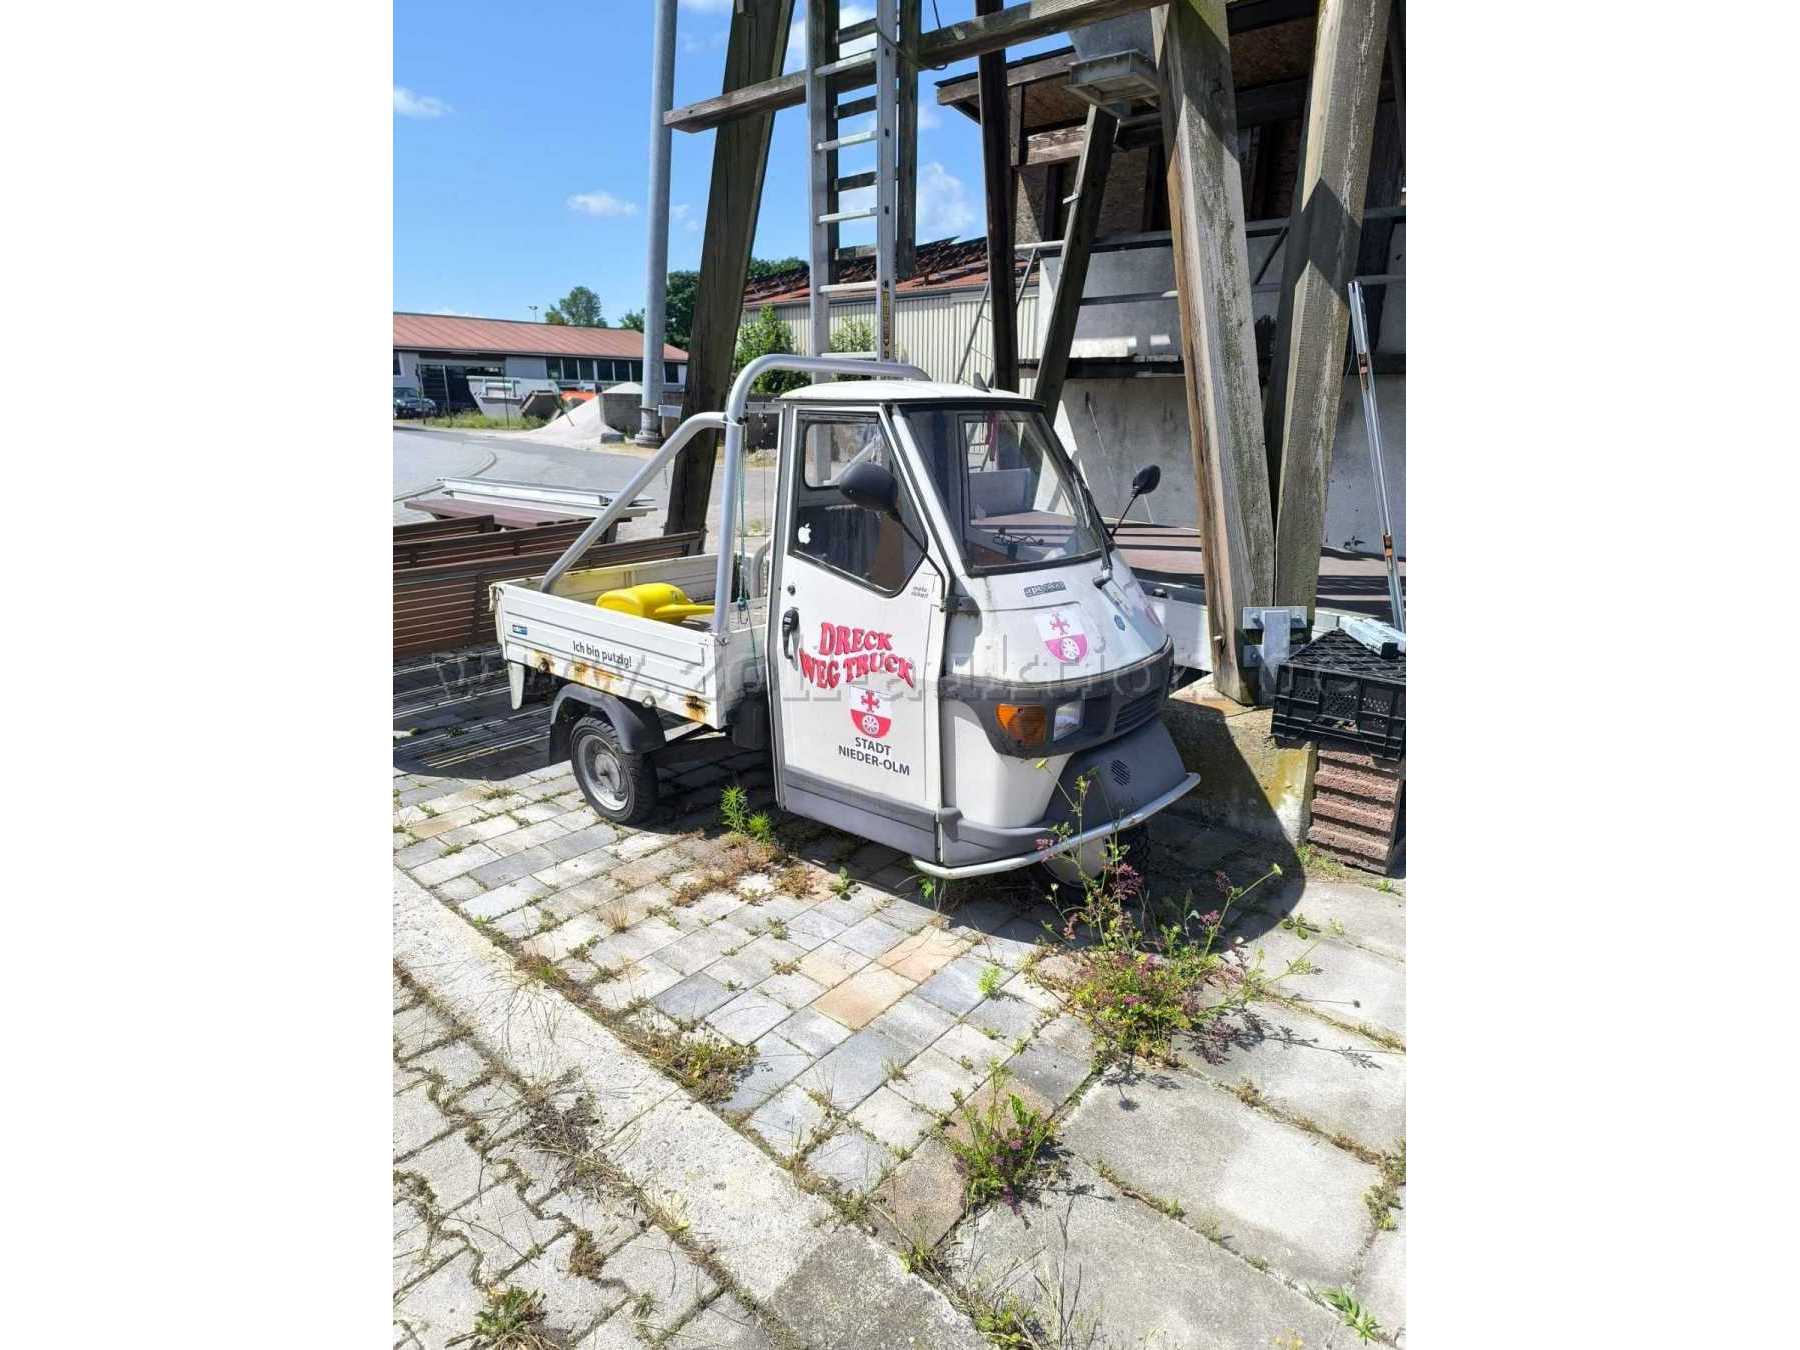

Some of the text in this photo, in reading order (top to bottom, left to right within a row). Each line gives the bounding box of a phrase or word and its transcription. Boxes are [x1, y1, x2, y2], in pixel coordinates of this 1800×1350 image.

[573, 640, 632, 669] Ich bin putzig!
[819, 622, 893, 656] DRECK
[799, 648, 914, 688] WEG TRUCK
[838, 745, 911, 776] NIEDER-OLM
[855, 737, 892, 756] STADT
